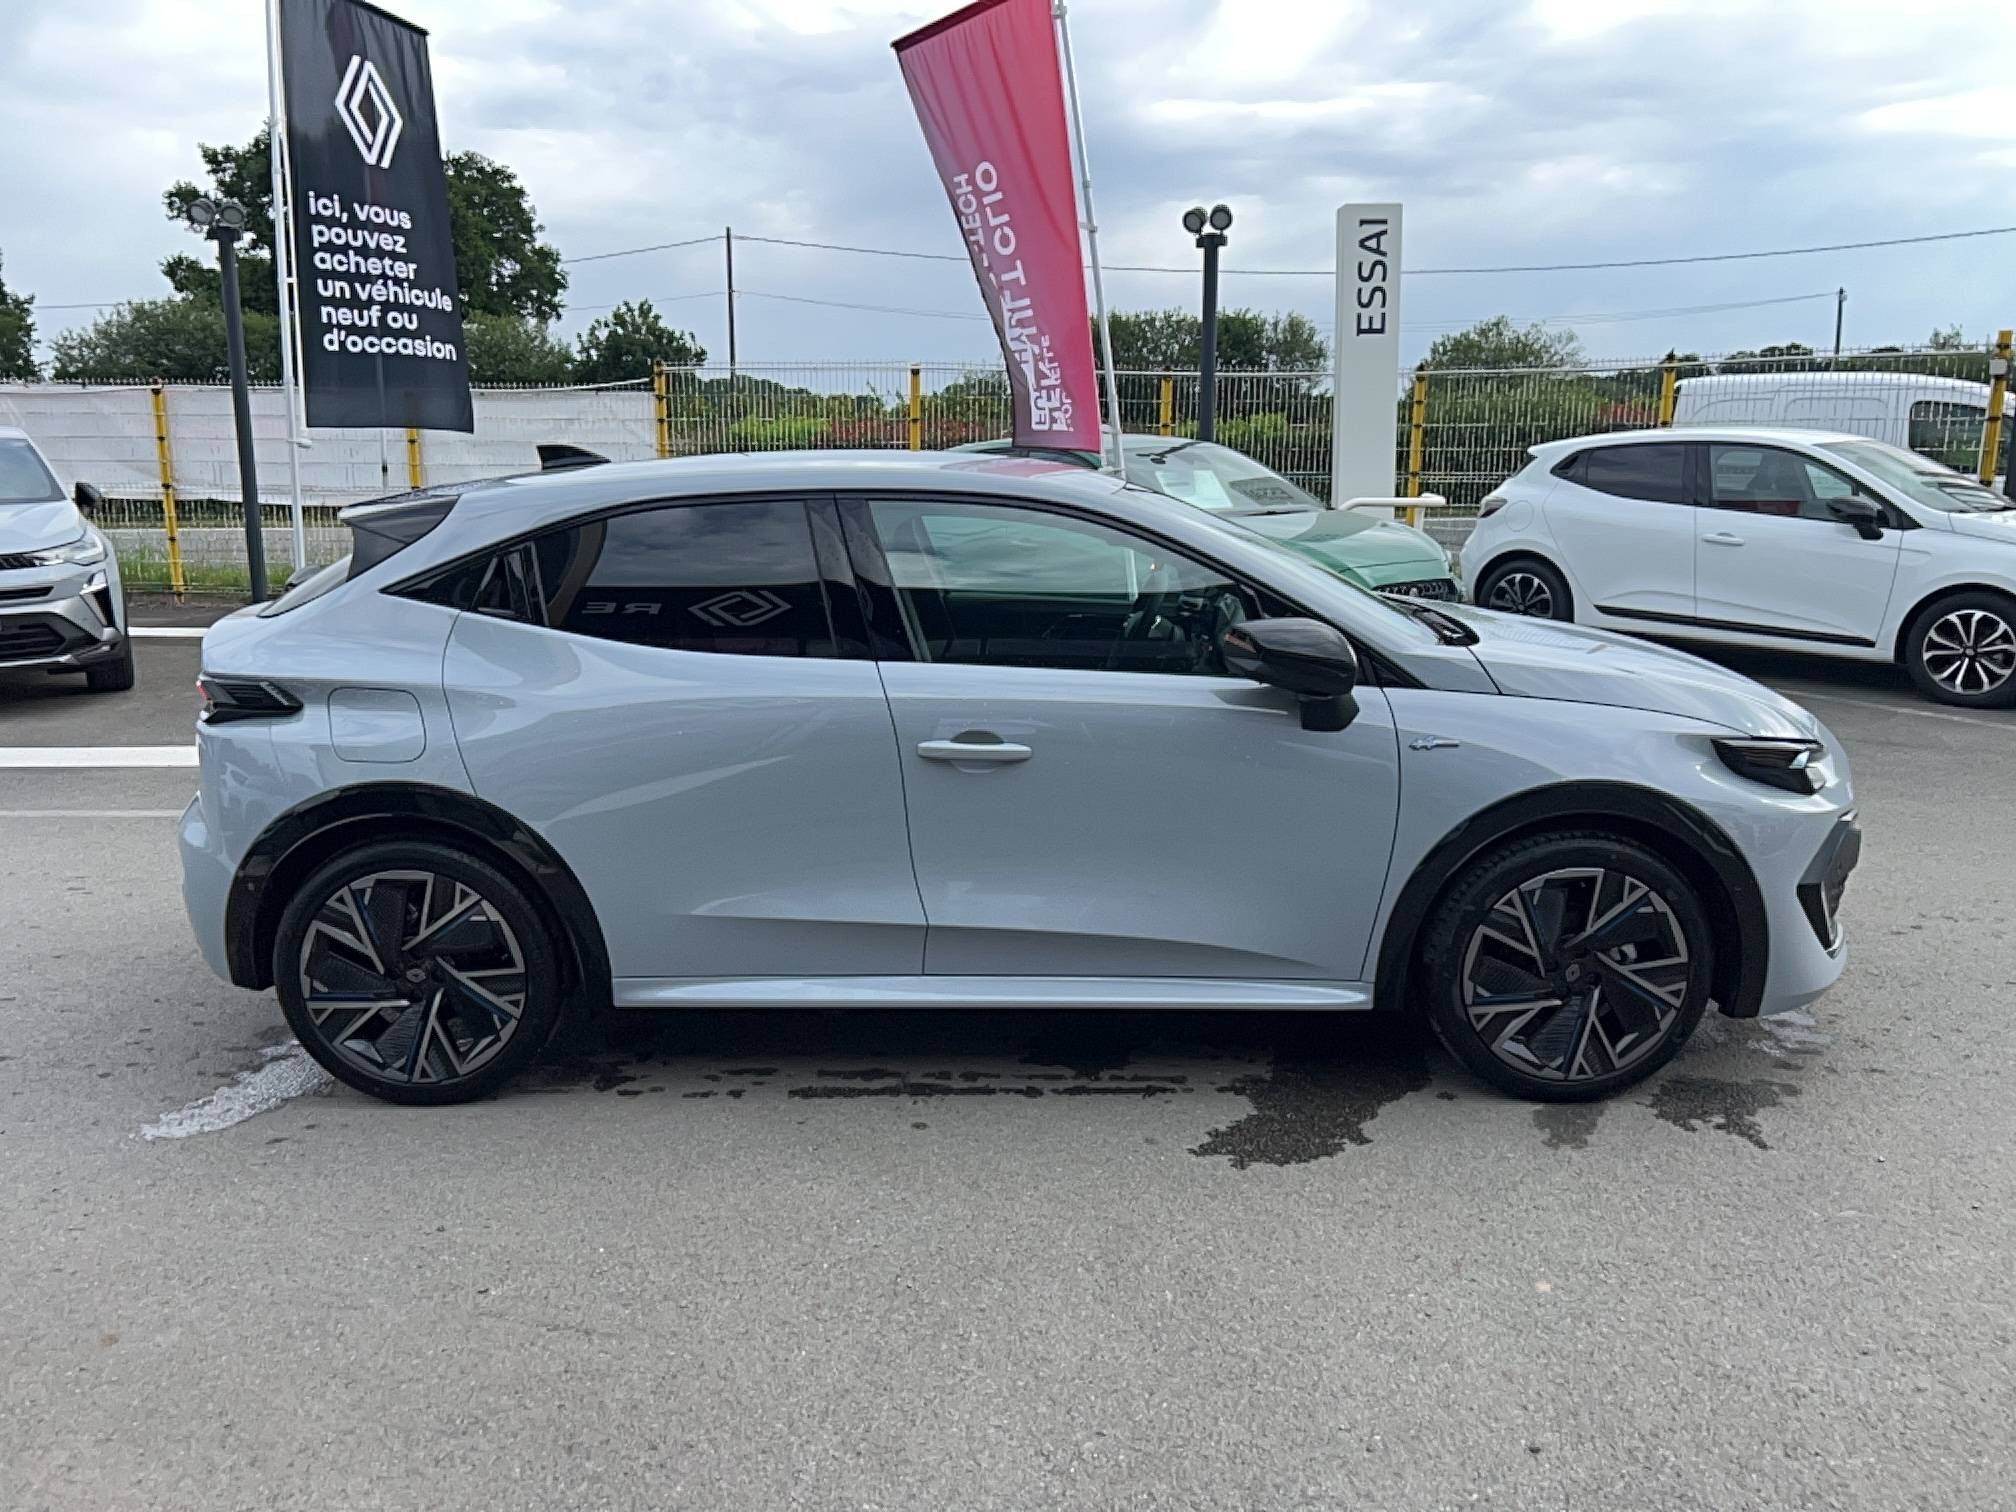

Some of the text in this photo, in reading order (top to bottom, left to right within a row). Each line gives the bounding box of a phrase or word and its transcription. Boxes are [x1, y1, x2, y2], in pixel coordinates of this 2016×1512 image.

[307, 190, 412, 230] ici, vous
[311, 224, 408, 254] pouvez
[313, 250, 418, 280] acheter
[1356, 218, 1389, 337] ESSAI
[316, 278, 453, 312] un véhicule
[320, 304, 418, 331] neuf ou
[322, 327, 458, 361] d'occasion
